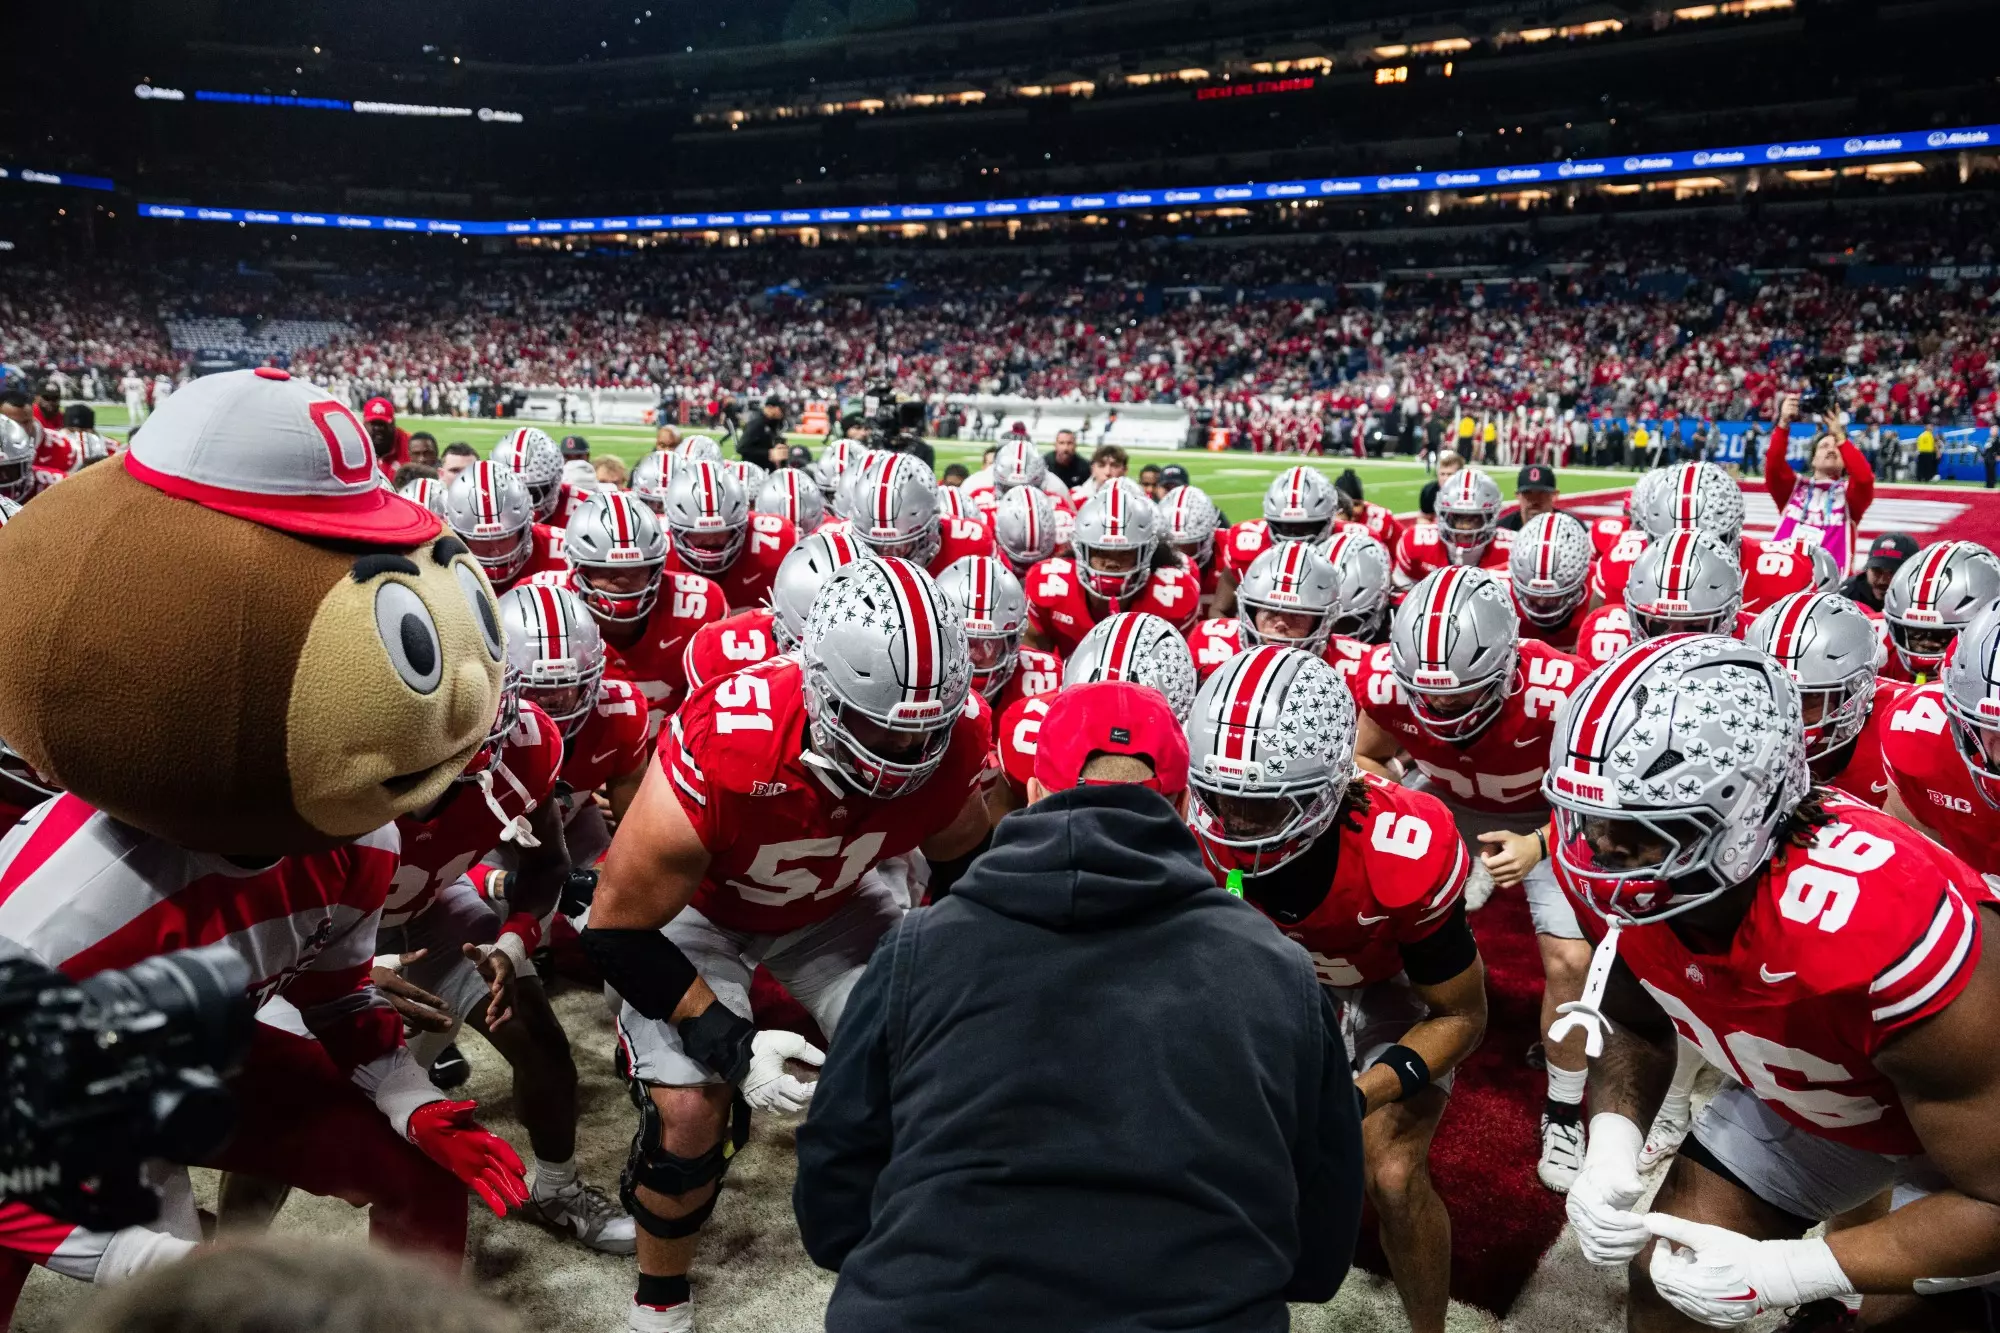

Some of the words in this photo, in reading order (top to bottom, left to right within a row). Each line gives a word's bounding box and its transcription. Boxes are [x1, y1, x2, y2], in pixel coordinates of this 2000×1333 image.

[673, 575, 709, 619] 56
[721, 629, 766, 661] 3
[715, 672, 774, 734] 51
[897, 708, 918, 719] OHIO
[919, 706, 942, 718] STATE
[1576, 783, 1604, 802] STATE
[1371, 811, 1433, 861] 6
[725, 831, 888, 907] 51
